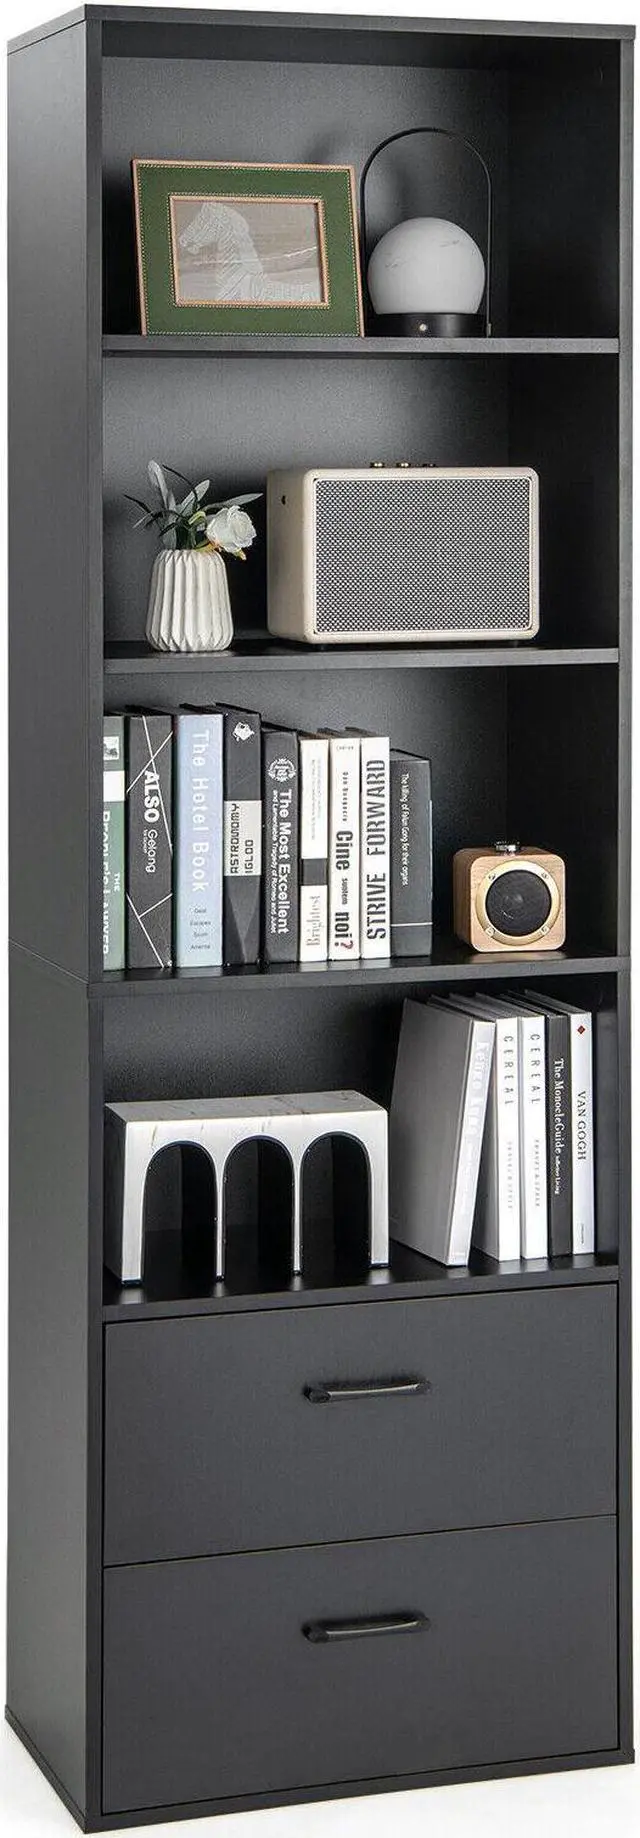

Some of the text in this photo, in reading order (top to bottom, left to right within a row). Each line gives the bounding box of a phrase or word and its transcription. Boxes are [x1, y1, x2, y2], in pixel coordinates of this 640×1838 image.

[144, 770, 160, 823] ALSO
[192, 729, 210, 892] The Hotel Book
[230, 803, 240, 874] ASTRONOMY
[245, 839, 254, 873] IGLOO
[277, 788, 292, 934] The Most Excellent
[335, 830, 353, 871] Cine
[366, 760, 386, 940] STRIVE FORWARD
[503, 1035, 514, 1105] CEREAL
[530, 1033, 541, 1104] CEREAL
[554, 1058, 564, 1079] The
[577, 1090, 587, 1160] VAN GOGH
